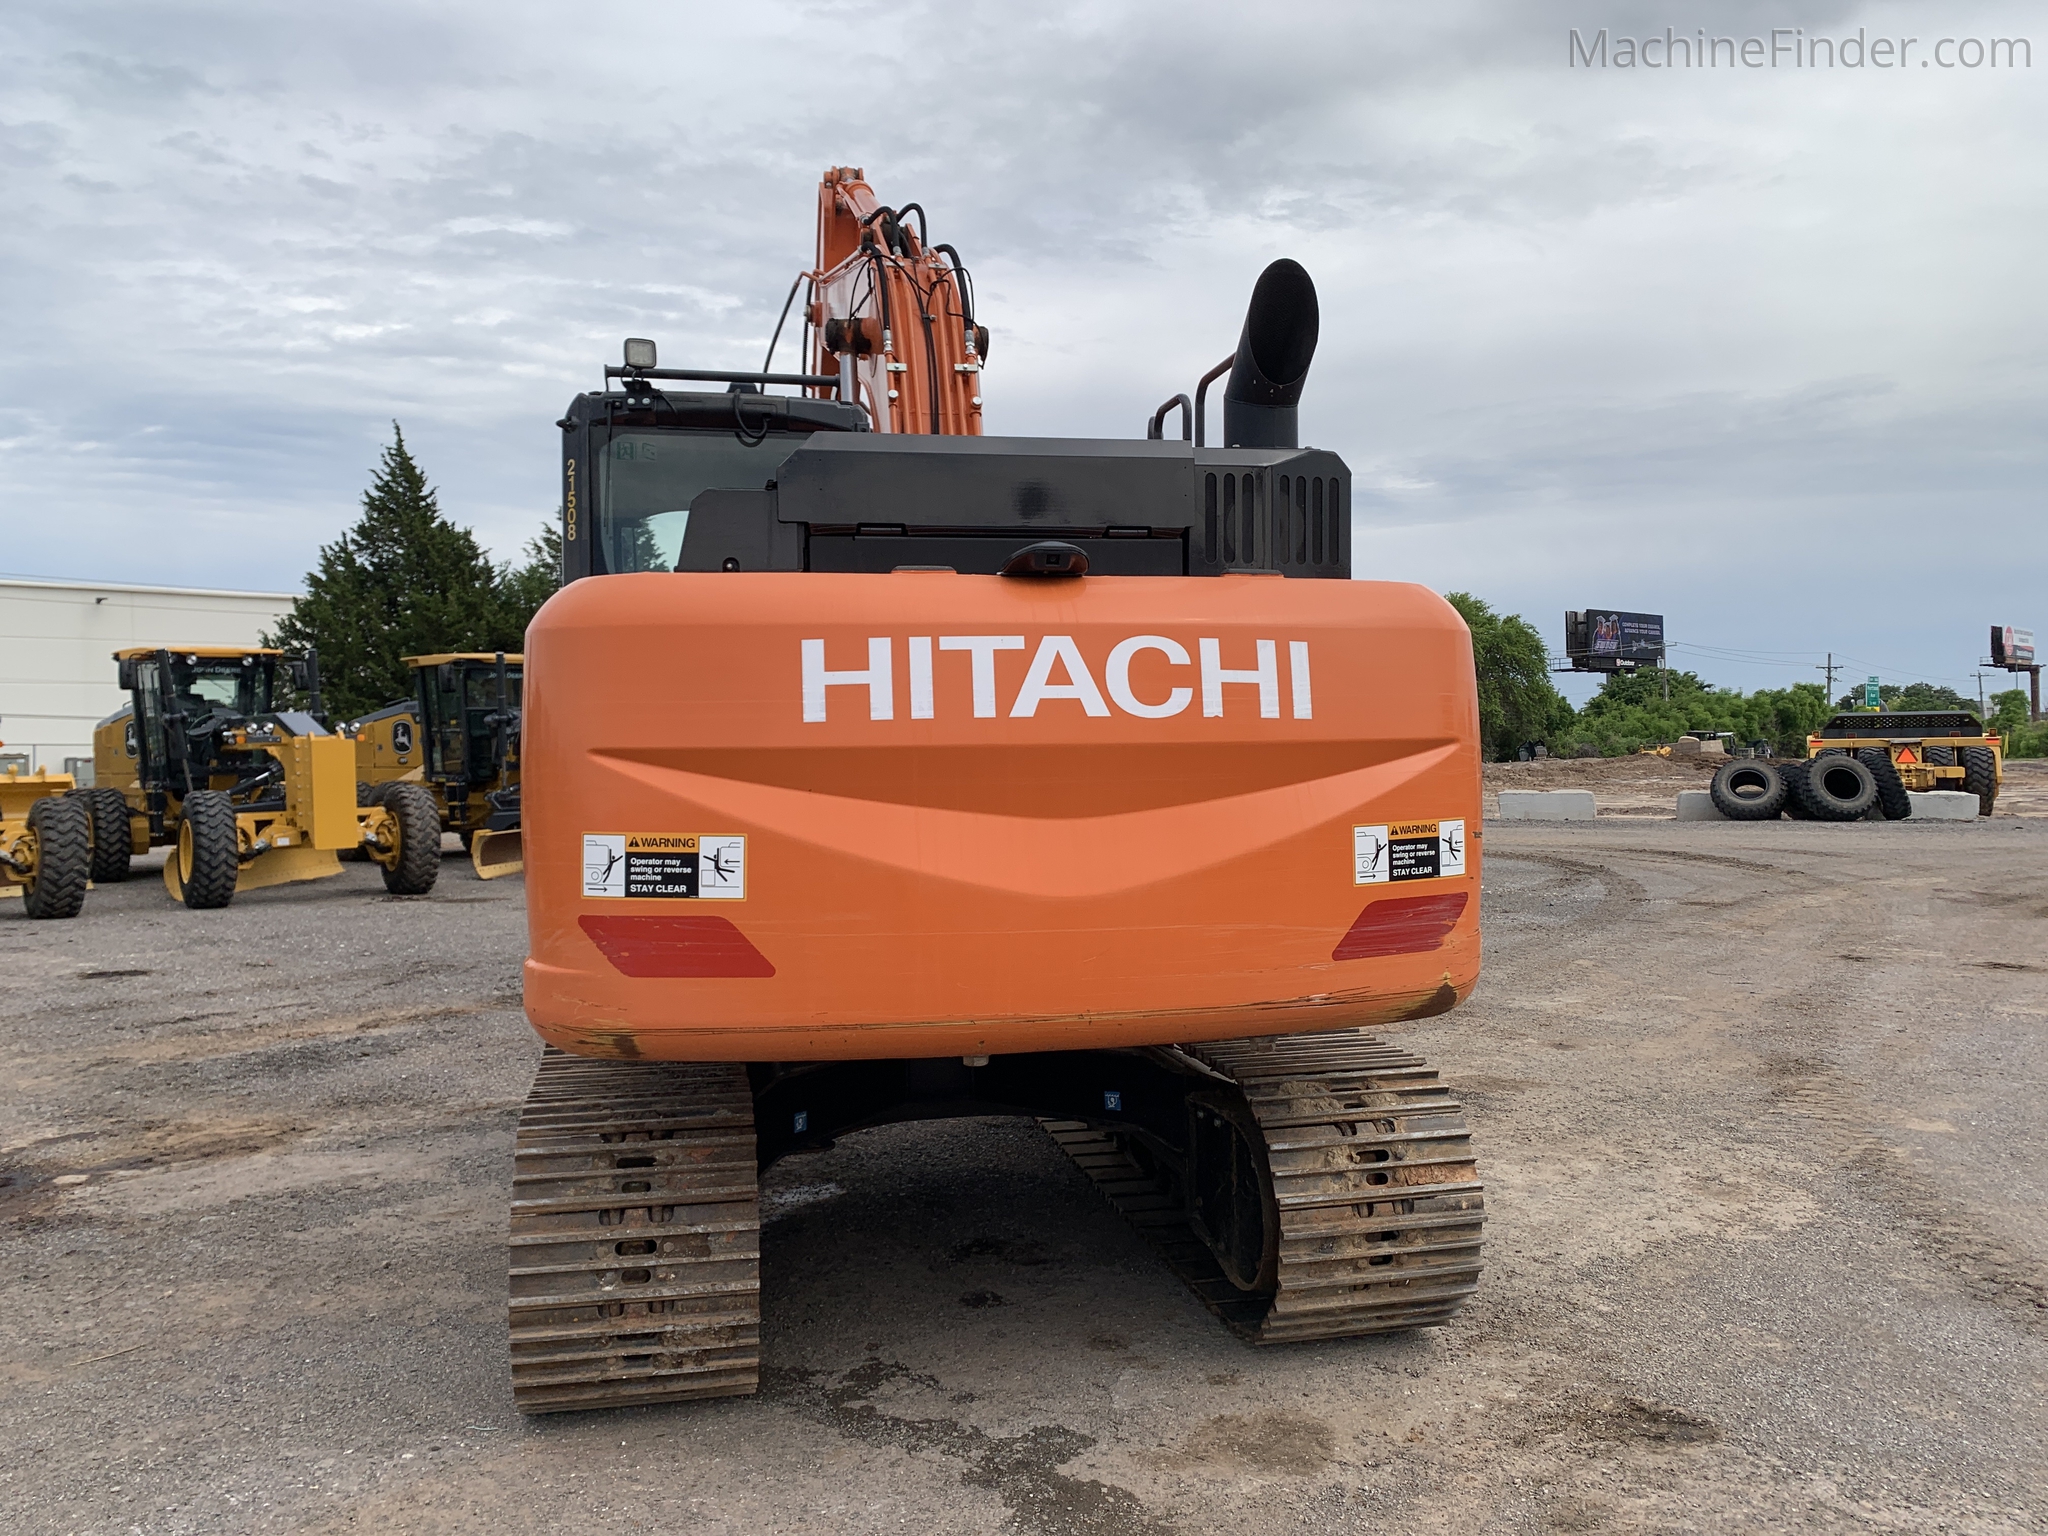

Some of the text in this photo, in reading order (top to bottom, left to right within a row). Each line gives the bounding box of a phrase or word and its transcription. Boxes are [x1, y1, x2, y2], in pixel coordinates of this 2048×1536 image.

[567, 459, 577, 541] 21508
[801, 635, 1314, 723] HITACHI
[1399, 824, 1437, 835] WARNING
[641, 837, 695, 848] WARNING
[1392, 844, 1416, 852] Operator
[630, 857, 681, 867] Operator may
[630, 866, 653, 874] swing
[1392, 866, 1433, 876] STAY CLEAR
[630, 884, 687, 893] STAY CLEAR
